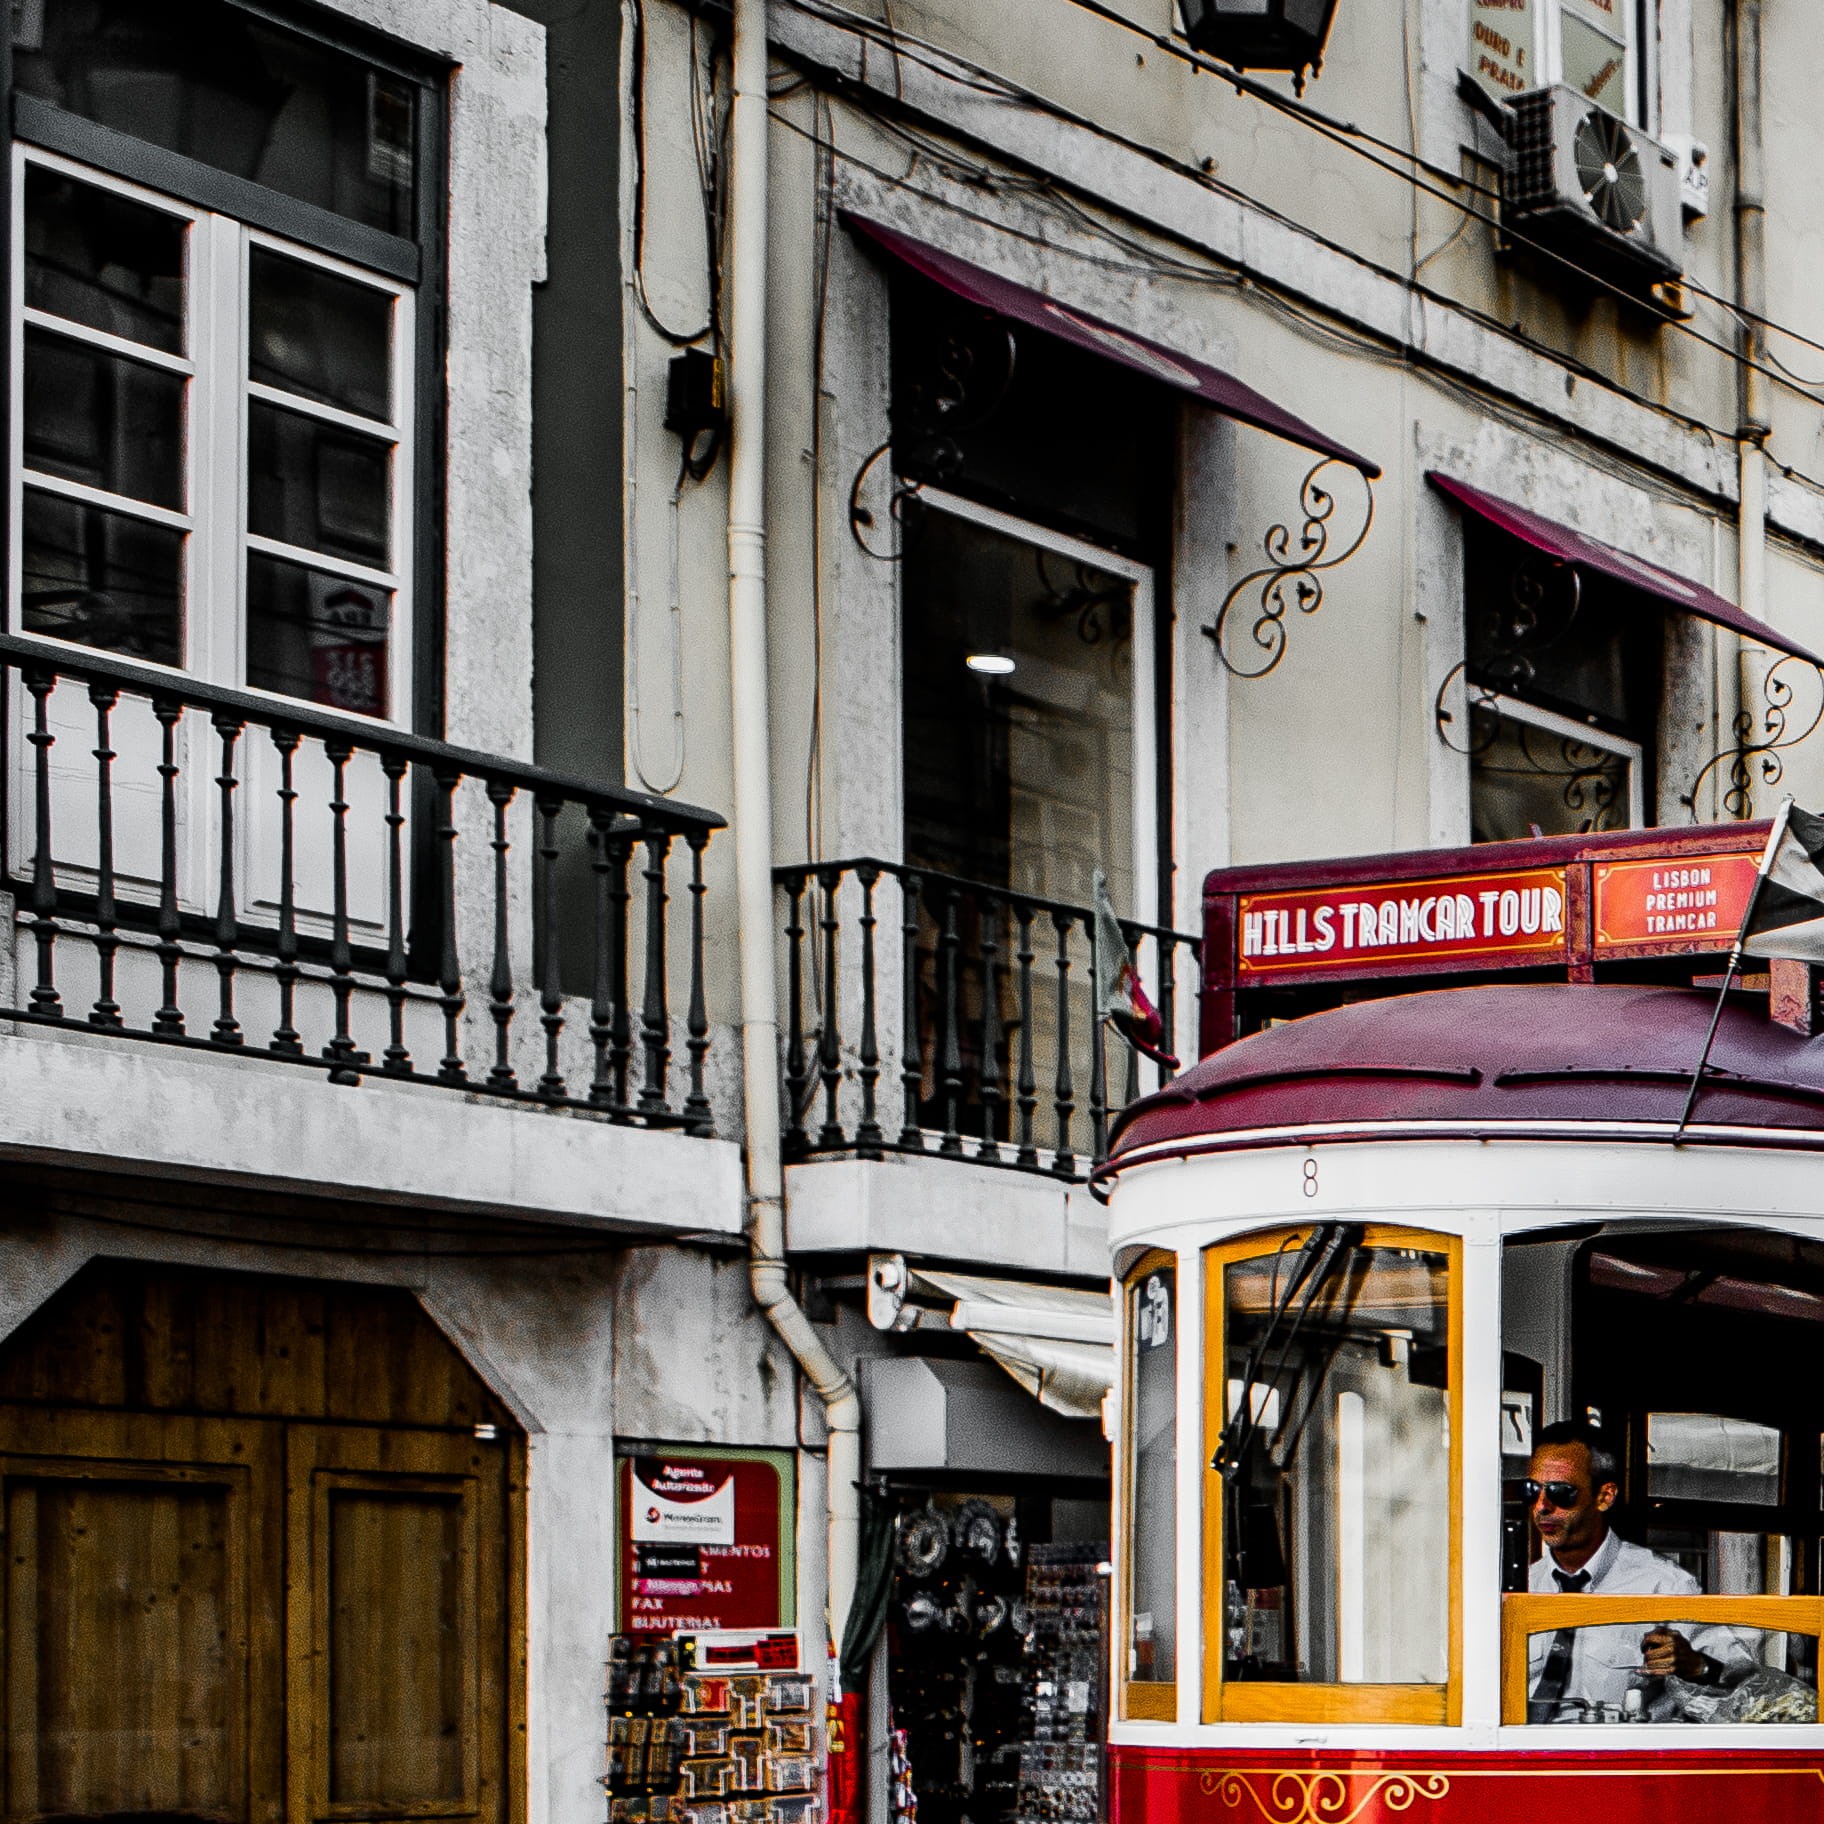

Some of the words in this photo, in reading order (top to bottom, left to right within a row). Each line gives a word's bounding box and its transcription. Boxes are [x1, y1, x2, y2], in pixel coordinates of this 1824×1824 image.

[1653, 868, 1711, 890] LISBON
[1646, 890, 1717, 912] PREMIUM
[1243, 906, 1335, 957] HILLS
[1339, 894, 1475, 949] TRAMCAR
[1479, 887, 1562, 937] TOUR
[1647, 912, 1717, 933] TRAMCAR
[1303, 1158, 1317, 1197] 8
[632, 1598, 664, 1610] FAX
